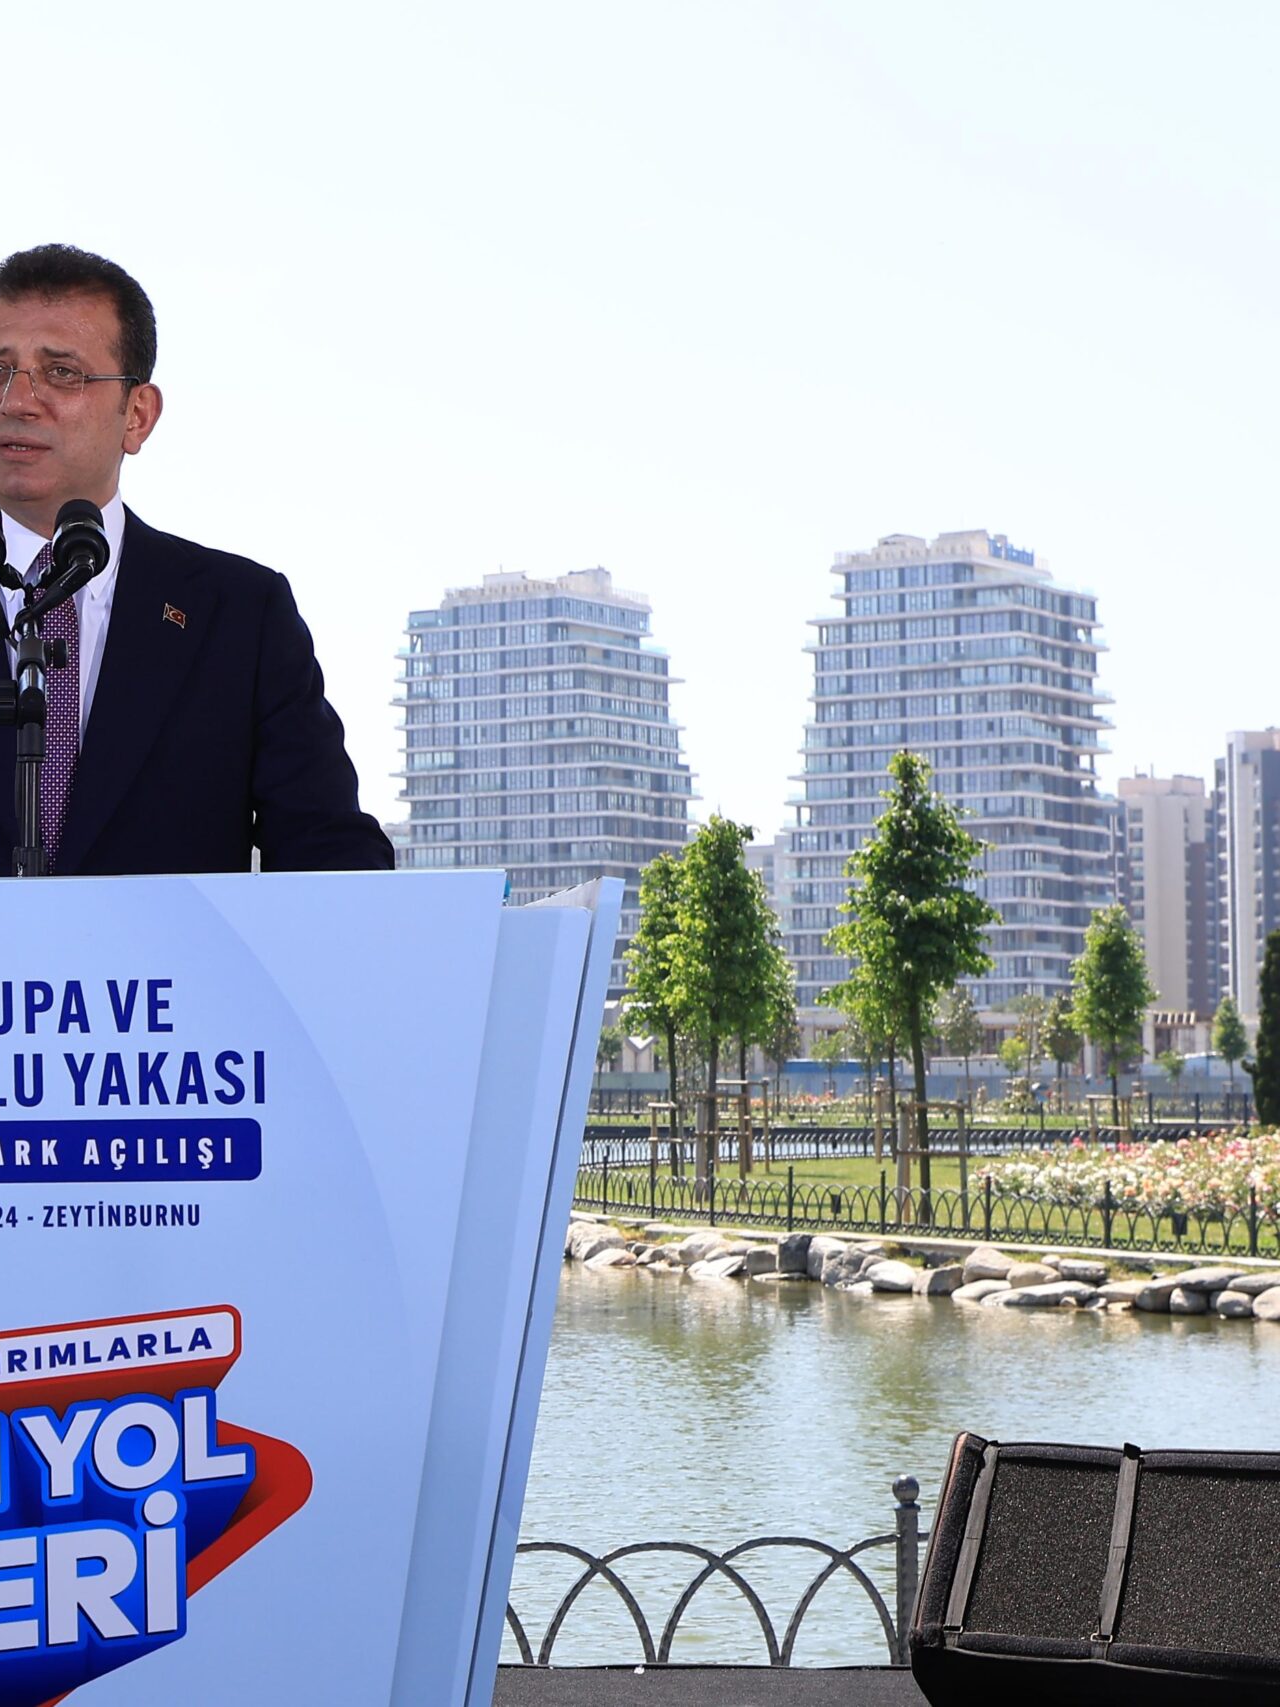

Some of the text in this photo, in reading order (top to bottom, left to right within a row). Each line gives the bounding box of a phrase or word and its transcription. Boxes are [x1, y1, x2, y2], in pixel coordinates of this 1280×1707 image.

[106, 979, 174, 1033] VE
[63, 1051, 266, 1106] YAKASI
[83, 1137, 233, 1170] AÇILIŞI
[42, 1201, 201, 1228] ZEYTİNBURNU
[20, 1395, 247, 1499] YOL
